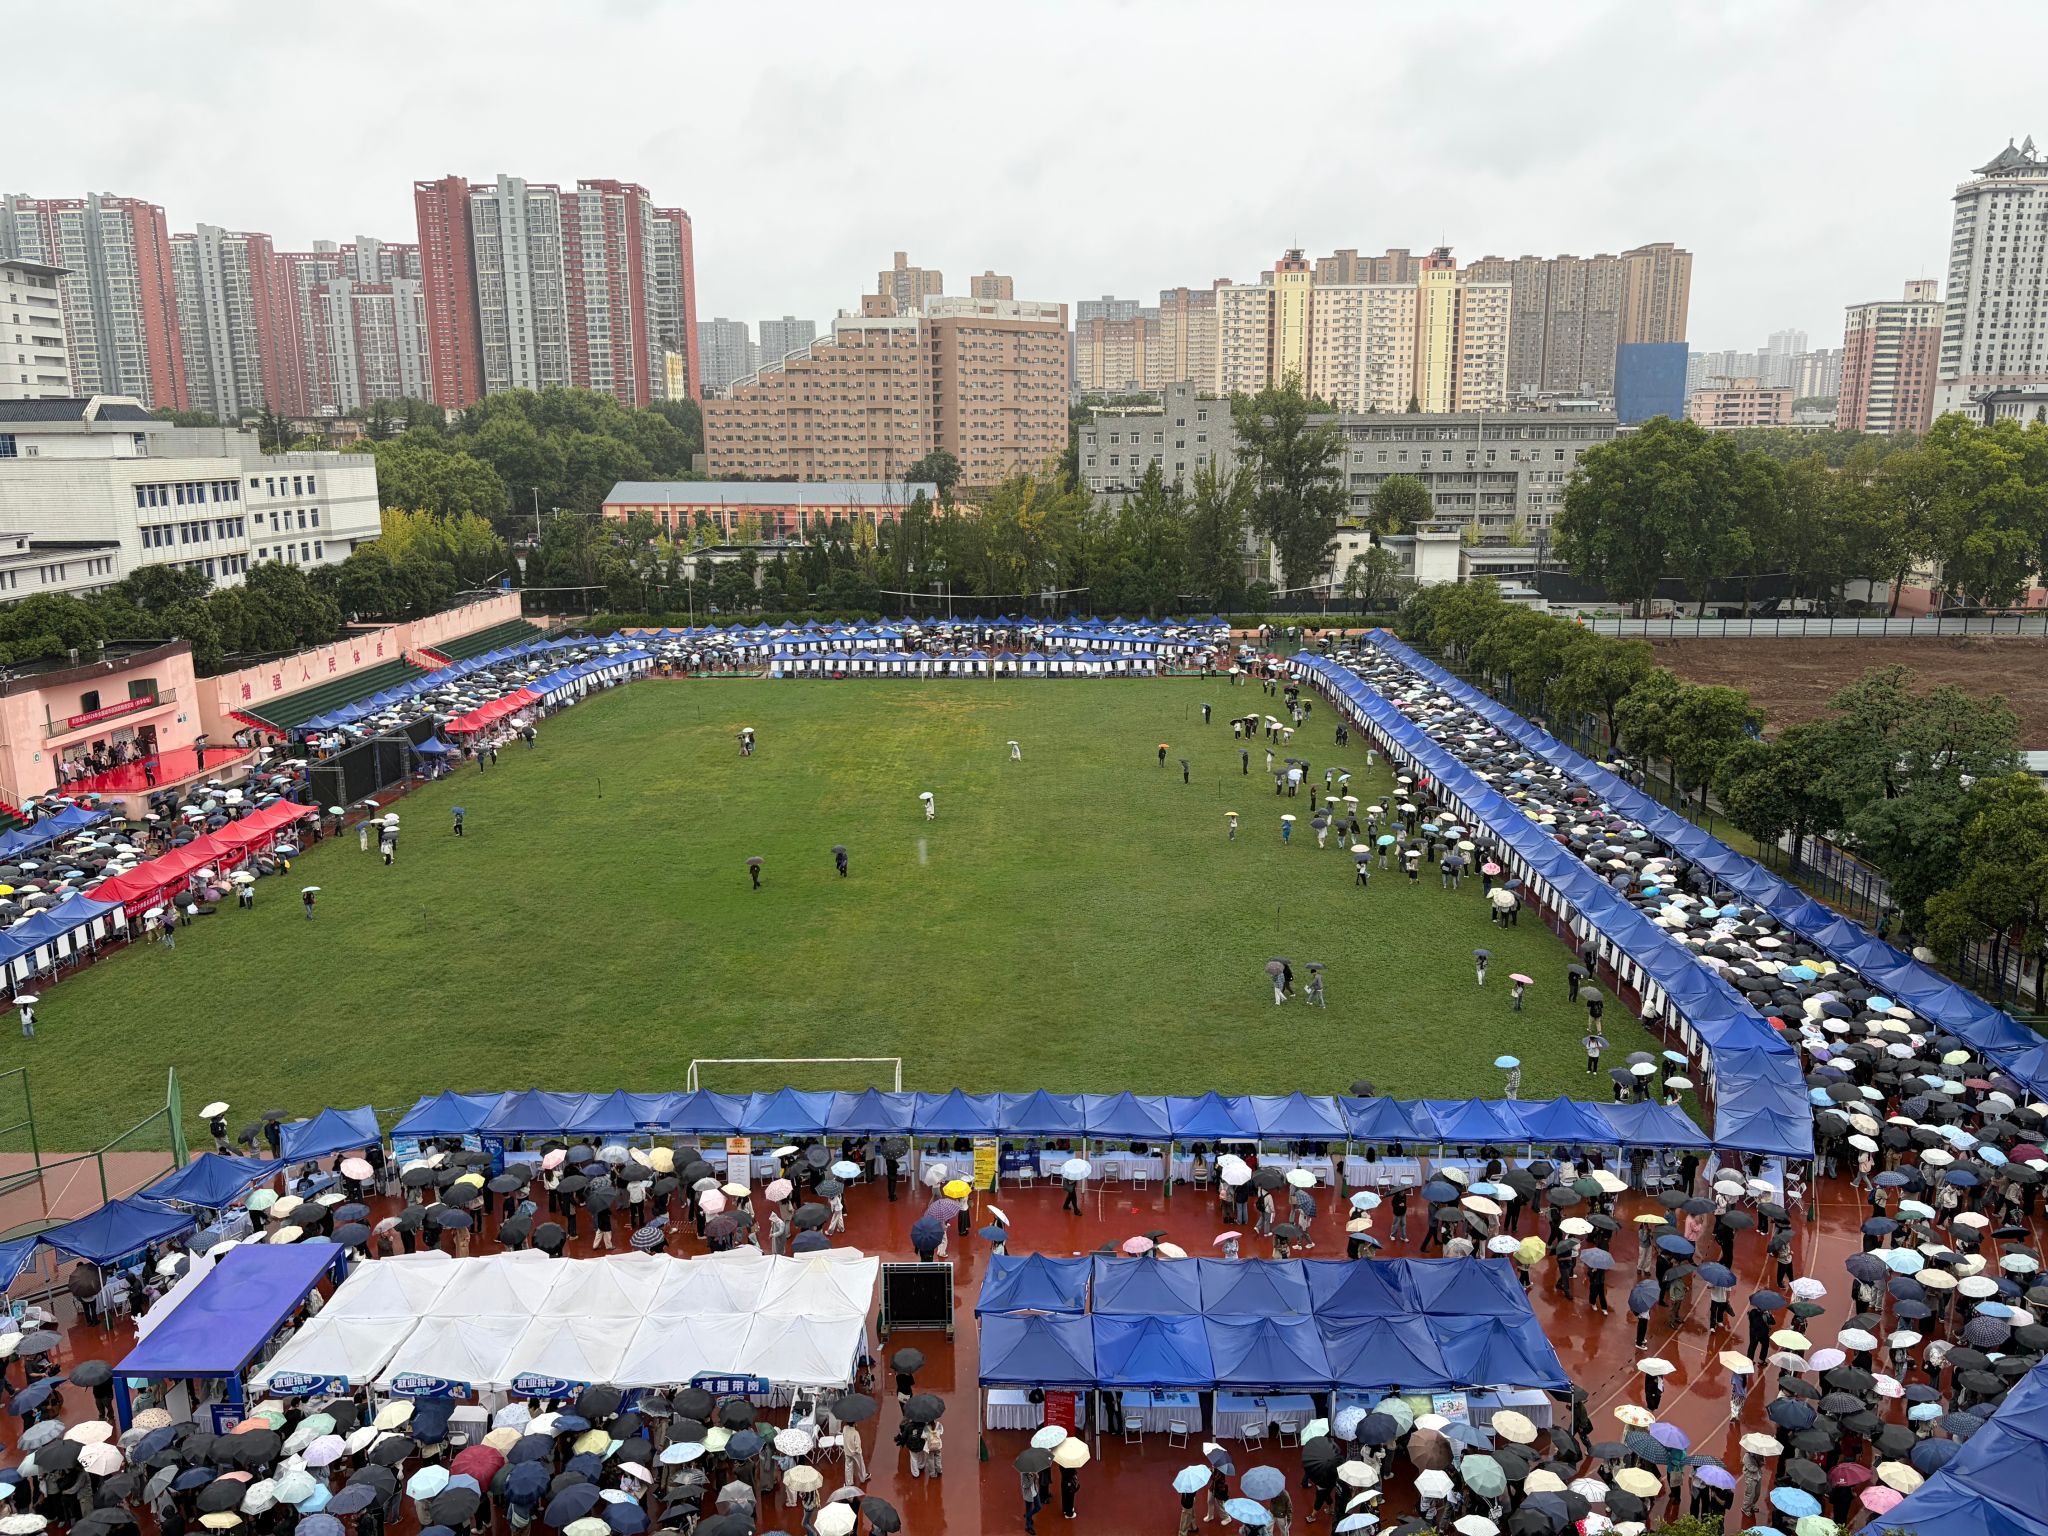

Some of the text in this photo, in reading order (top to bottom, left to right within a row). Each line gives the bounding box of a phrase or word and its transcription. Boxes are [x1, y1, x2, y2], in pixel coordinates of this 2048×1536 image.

[241, 642, 383, 700] 增强人民体质
[273, 1374, 313, 1388] 就业指导
[396, 1377, 437, 1389] 就业指导
[517, 1377, 557, 1389] 就业指导
[702, 1380, 760, 1392] 直播带岗
